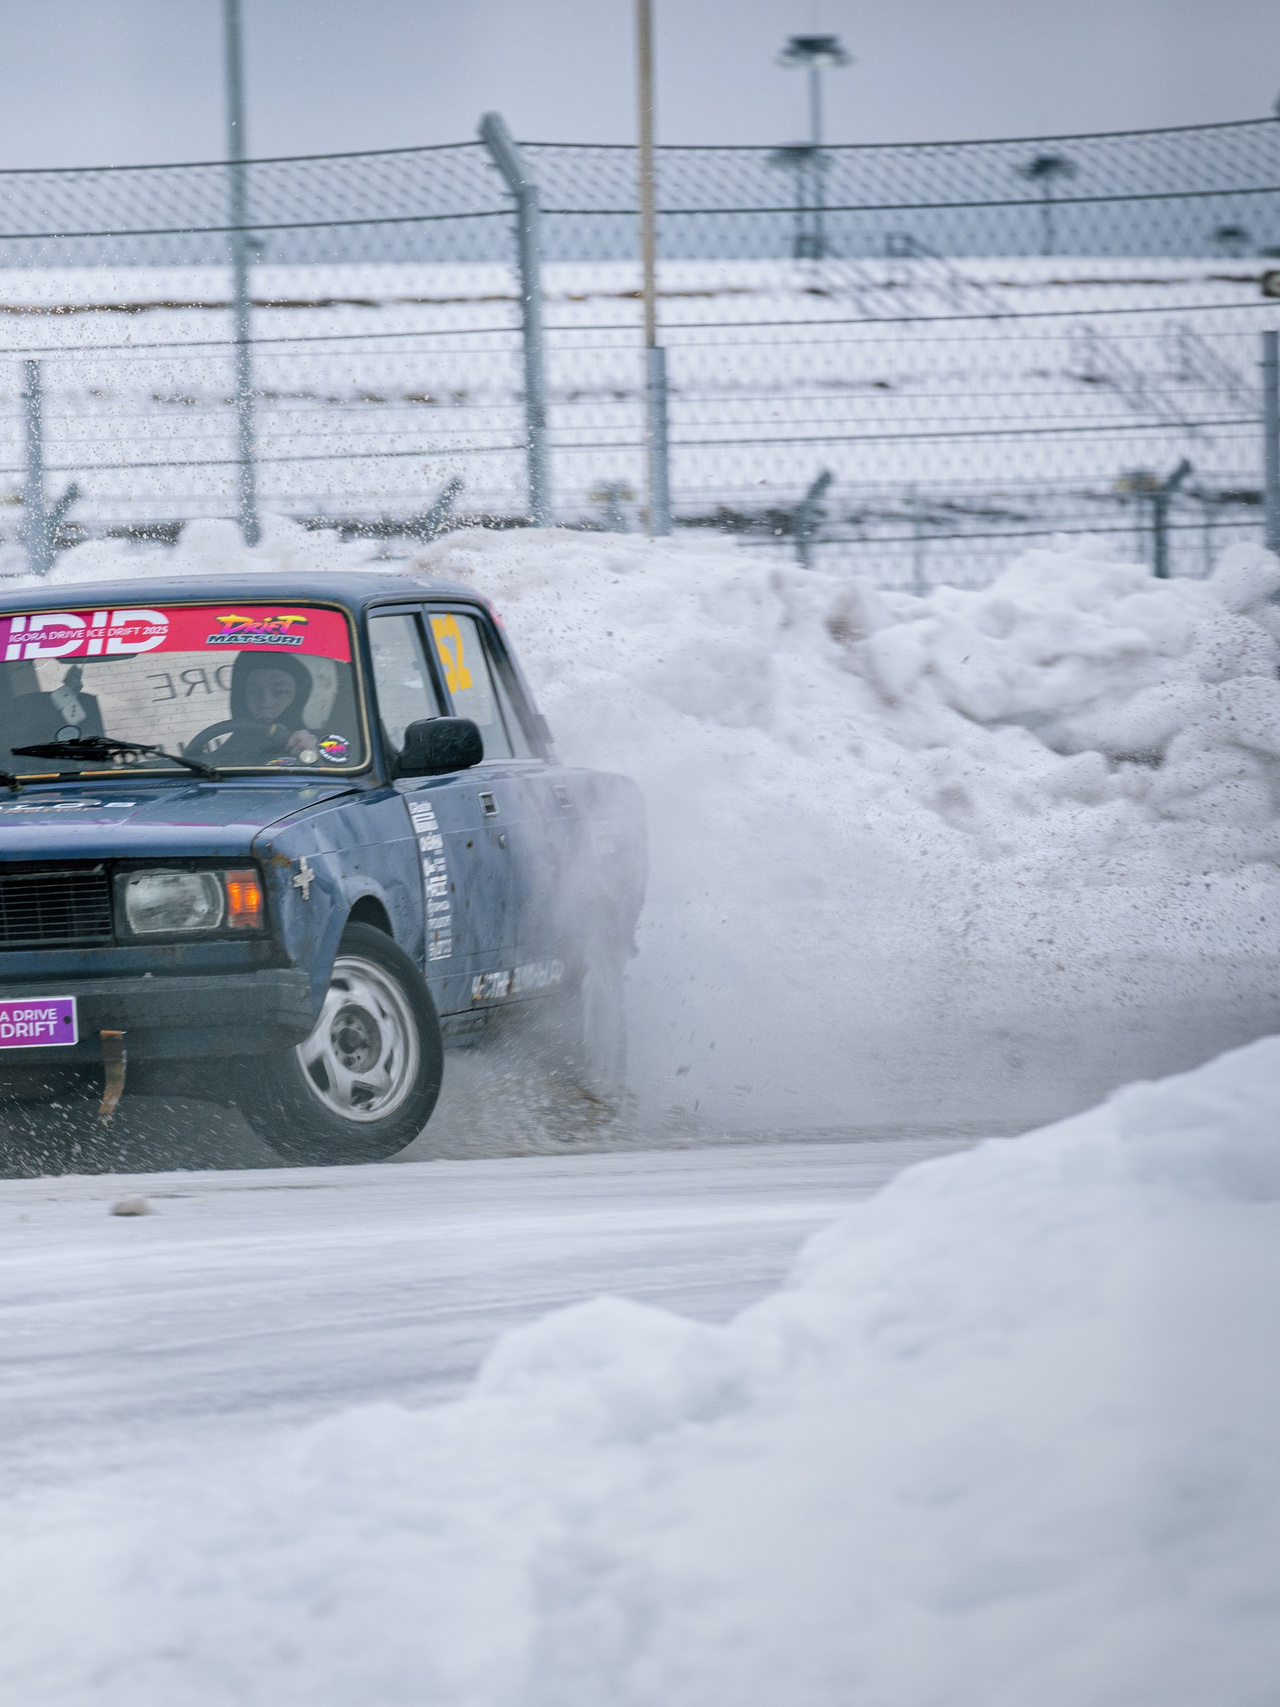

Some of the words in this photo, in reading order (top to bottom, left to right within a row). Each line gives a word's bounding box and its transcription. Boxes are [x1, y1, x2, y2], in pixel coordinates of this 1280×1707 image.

[5, 609, 170, 661] IDID
[8, 631, 48, 643] IGORA
[49, 629, 85, 640] DRIVE
[86, 627, 106, 638] ICE
[107, 626, 140, 637] DRIFT
[143, 625, 169, 635] 2025
[206, 633, 304, 646] MATSURI
[431, 612, 473, 693] 52
[13, 1008, 58, 1022] DRIVE
[0, 1021, 58, 1038] DRIFT
